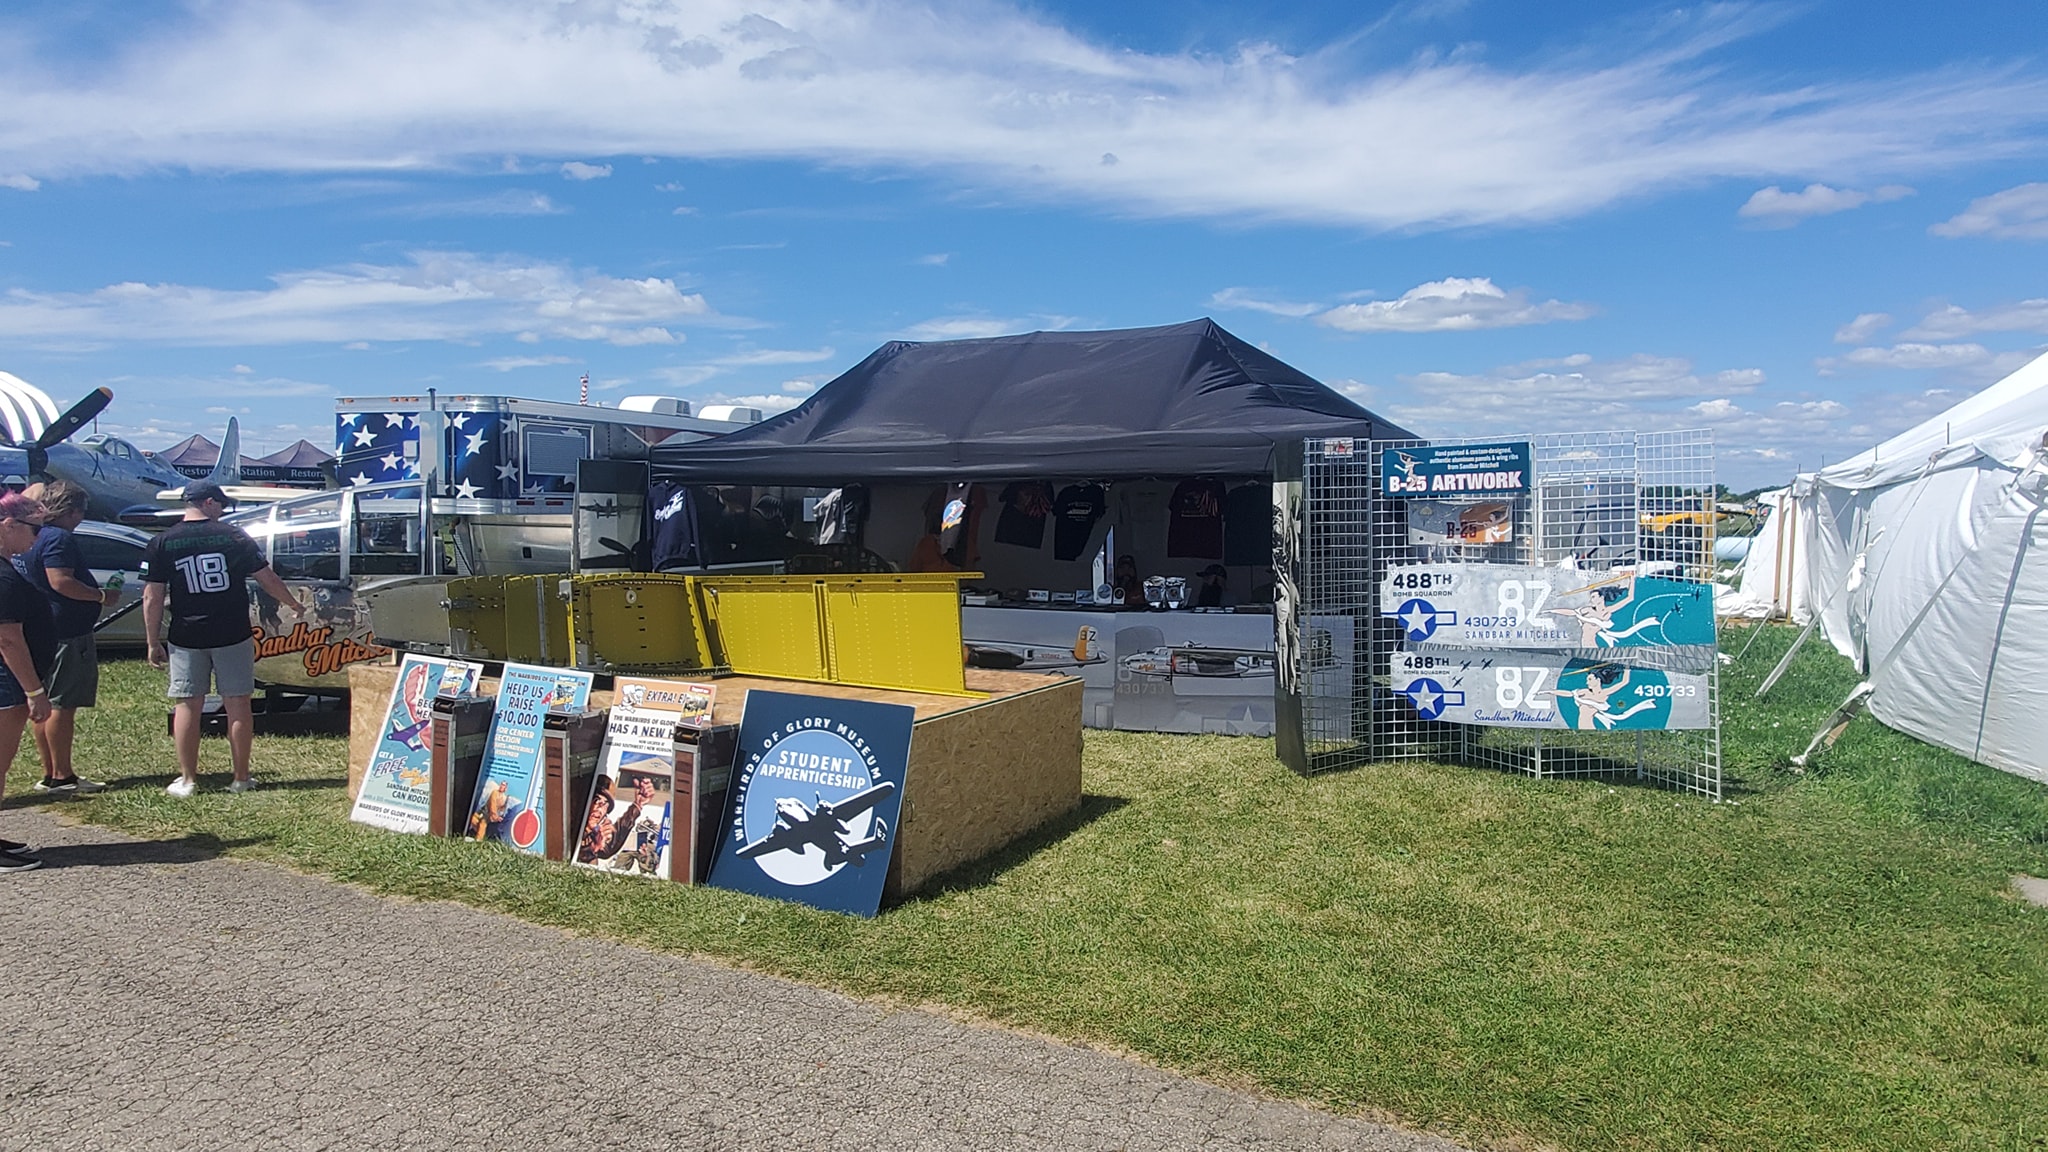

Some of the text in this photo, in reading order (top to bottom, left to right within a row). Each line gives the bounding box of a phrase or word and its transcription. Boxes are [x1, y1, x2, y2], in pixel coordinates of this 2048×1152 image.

[1447, 449, 1465, 457] painted
[1475, 455, 1492, 463] panels
[1496, 454, 1508, 462] wing
[178, 467, 211, 476] Restor
[240, 467, 276, 477] Station
[1460, 462, 1479, 470] Sandbar
[1479, 461, 1500, 469] Mitchell
[1389, 470, 1523, 493] B-25 ARTWORK
[1446, 521, 1477, 539] B-25
[175, 552, 231, 594] 18
[1393, 573, 1452, 589] 488TH
[1498, 579, 1556, 630] 8Z
[1464, 616, 1517, 628] 430733
[1465, 630, 1568, 639] SANDBAR MITCHELL
[251, 622, 333, 663] Sandbar
[1404, 656, 1450, 669] 488TH
[518, 673, 541, 681] WARBIRDS
[506, 682, 544, 698] HELP US
[1116, 684, 1165, 695] 430733
[1495, 666, 1551, 709] 8Z
[1634, 685, 1696, 697] 430733
[646, 690, 677, 702] EXTRA!
[417, 699, 434, 709] BEC
[508, 696, 535, 711] RAISE
[498, 709, 538, 727] $10,000
[624, 716, 651, 724] WARBIRDS
[660, 719, 677, 727] GLORY
[1473, 709, 1555, 722] Sandbar Mitchell
[497, 726, 535, 739] FOR CENTER
[609, 723, 630, 734] HAS
[631, 725, 638, 735] A
[641, 726, 666, 738] NEW
[378, 751, 389, 759] GET
[778, 750, 853, 774] STUDENT
[373, 756, 408, 777] FREE
[734, 717, 882, 842] WARBIRDS OF GLORY MUSEUM
[760, 763, 866, 790] APPRENTICESHIP
[386, 782, 430, 796] SANDBAR MITCHE
[392, 791, 405, 800] CAN
[408, 792, 430, 805] KOOZI
[359, 803, 382, 812] WARBIRDS
[390, 808, 406, 817] GLORY
[406, 812, 429, 822] MUSEUM
